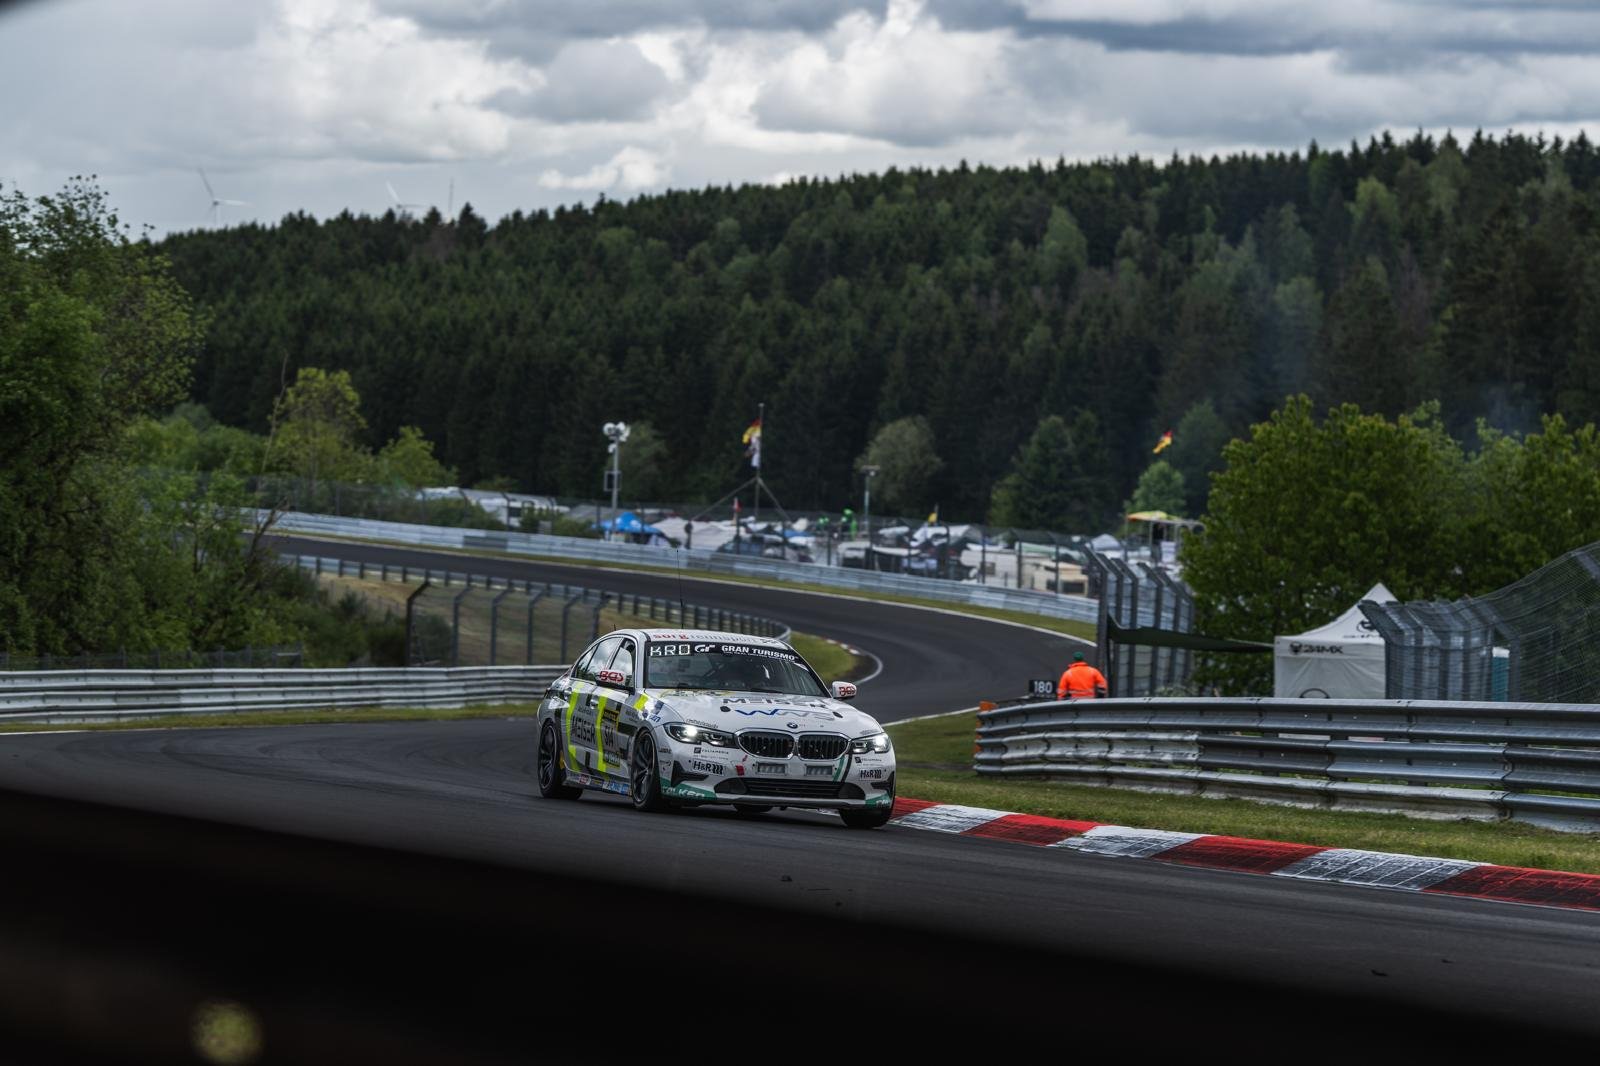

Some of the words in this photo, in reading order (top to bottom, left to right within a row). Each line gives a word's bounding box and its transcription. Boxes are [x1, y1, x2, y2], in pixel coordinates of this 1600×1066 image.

[722, 645, 749, 653] GRAN
[752, 648, 795, 661] TURISMO
[1034, 680, 1053, 694] 180
[571, 715, 595, 744] MEISER
